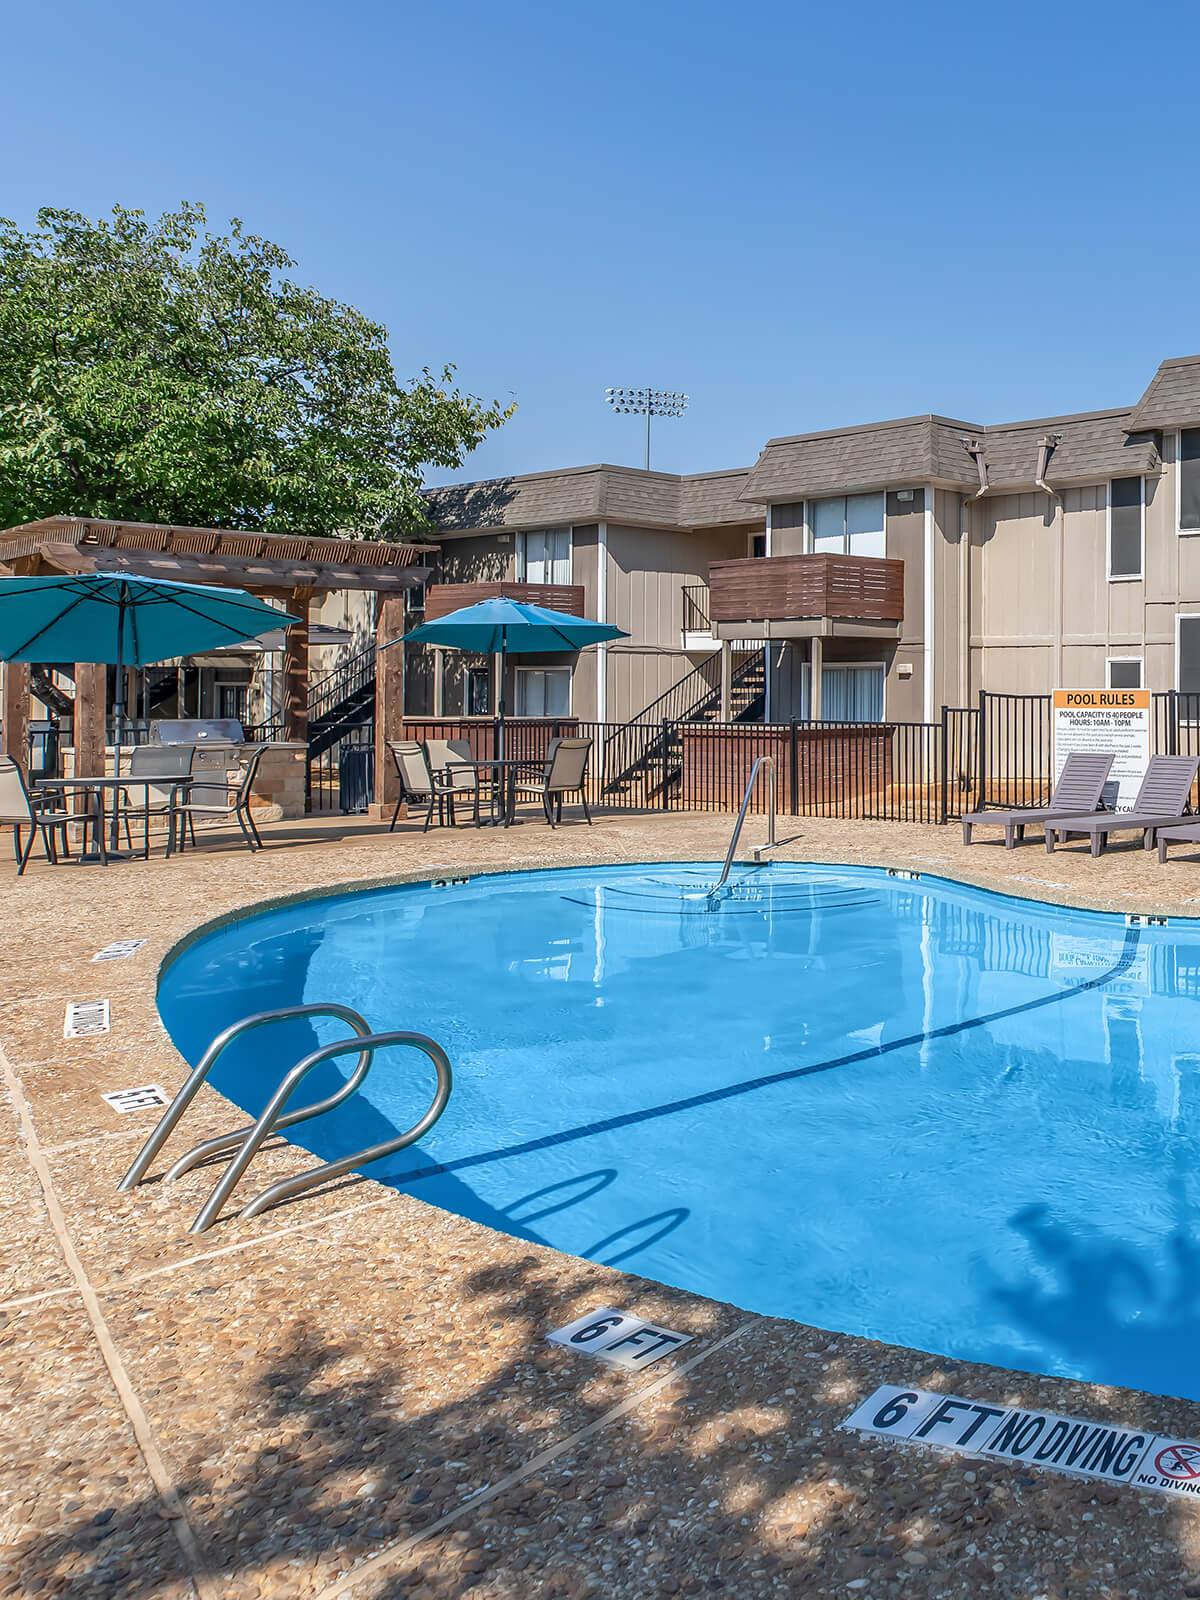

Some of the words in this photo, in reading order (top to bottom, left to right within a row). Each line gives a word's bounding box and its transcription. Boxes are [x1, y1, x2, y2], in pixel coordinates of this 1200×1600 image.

[1067, 694, 1097, 705] POOL
[1100, 694, 1135, 705] RULES
[1120, 711, 1143, 719] PEOPLE
[1148, 917, 1167, 926] FT
[107, 1088, 156, 1100] 5
[119, 1095, 165, 1110] FT
[570, 1317, 624, 1343] 6
[606, 1328, 682, 1360] FT
[872, 1393, 918, 1428] 6
[916, 1400, 1004, 1446] FT
[988, 1414, 1046, 1457] NO
[1035, 1421, 1145, 1476] DIVING
[1137, 1474, 1157, 1486] NO
